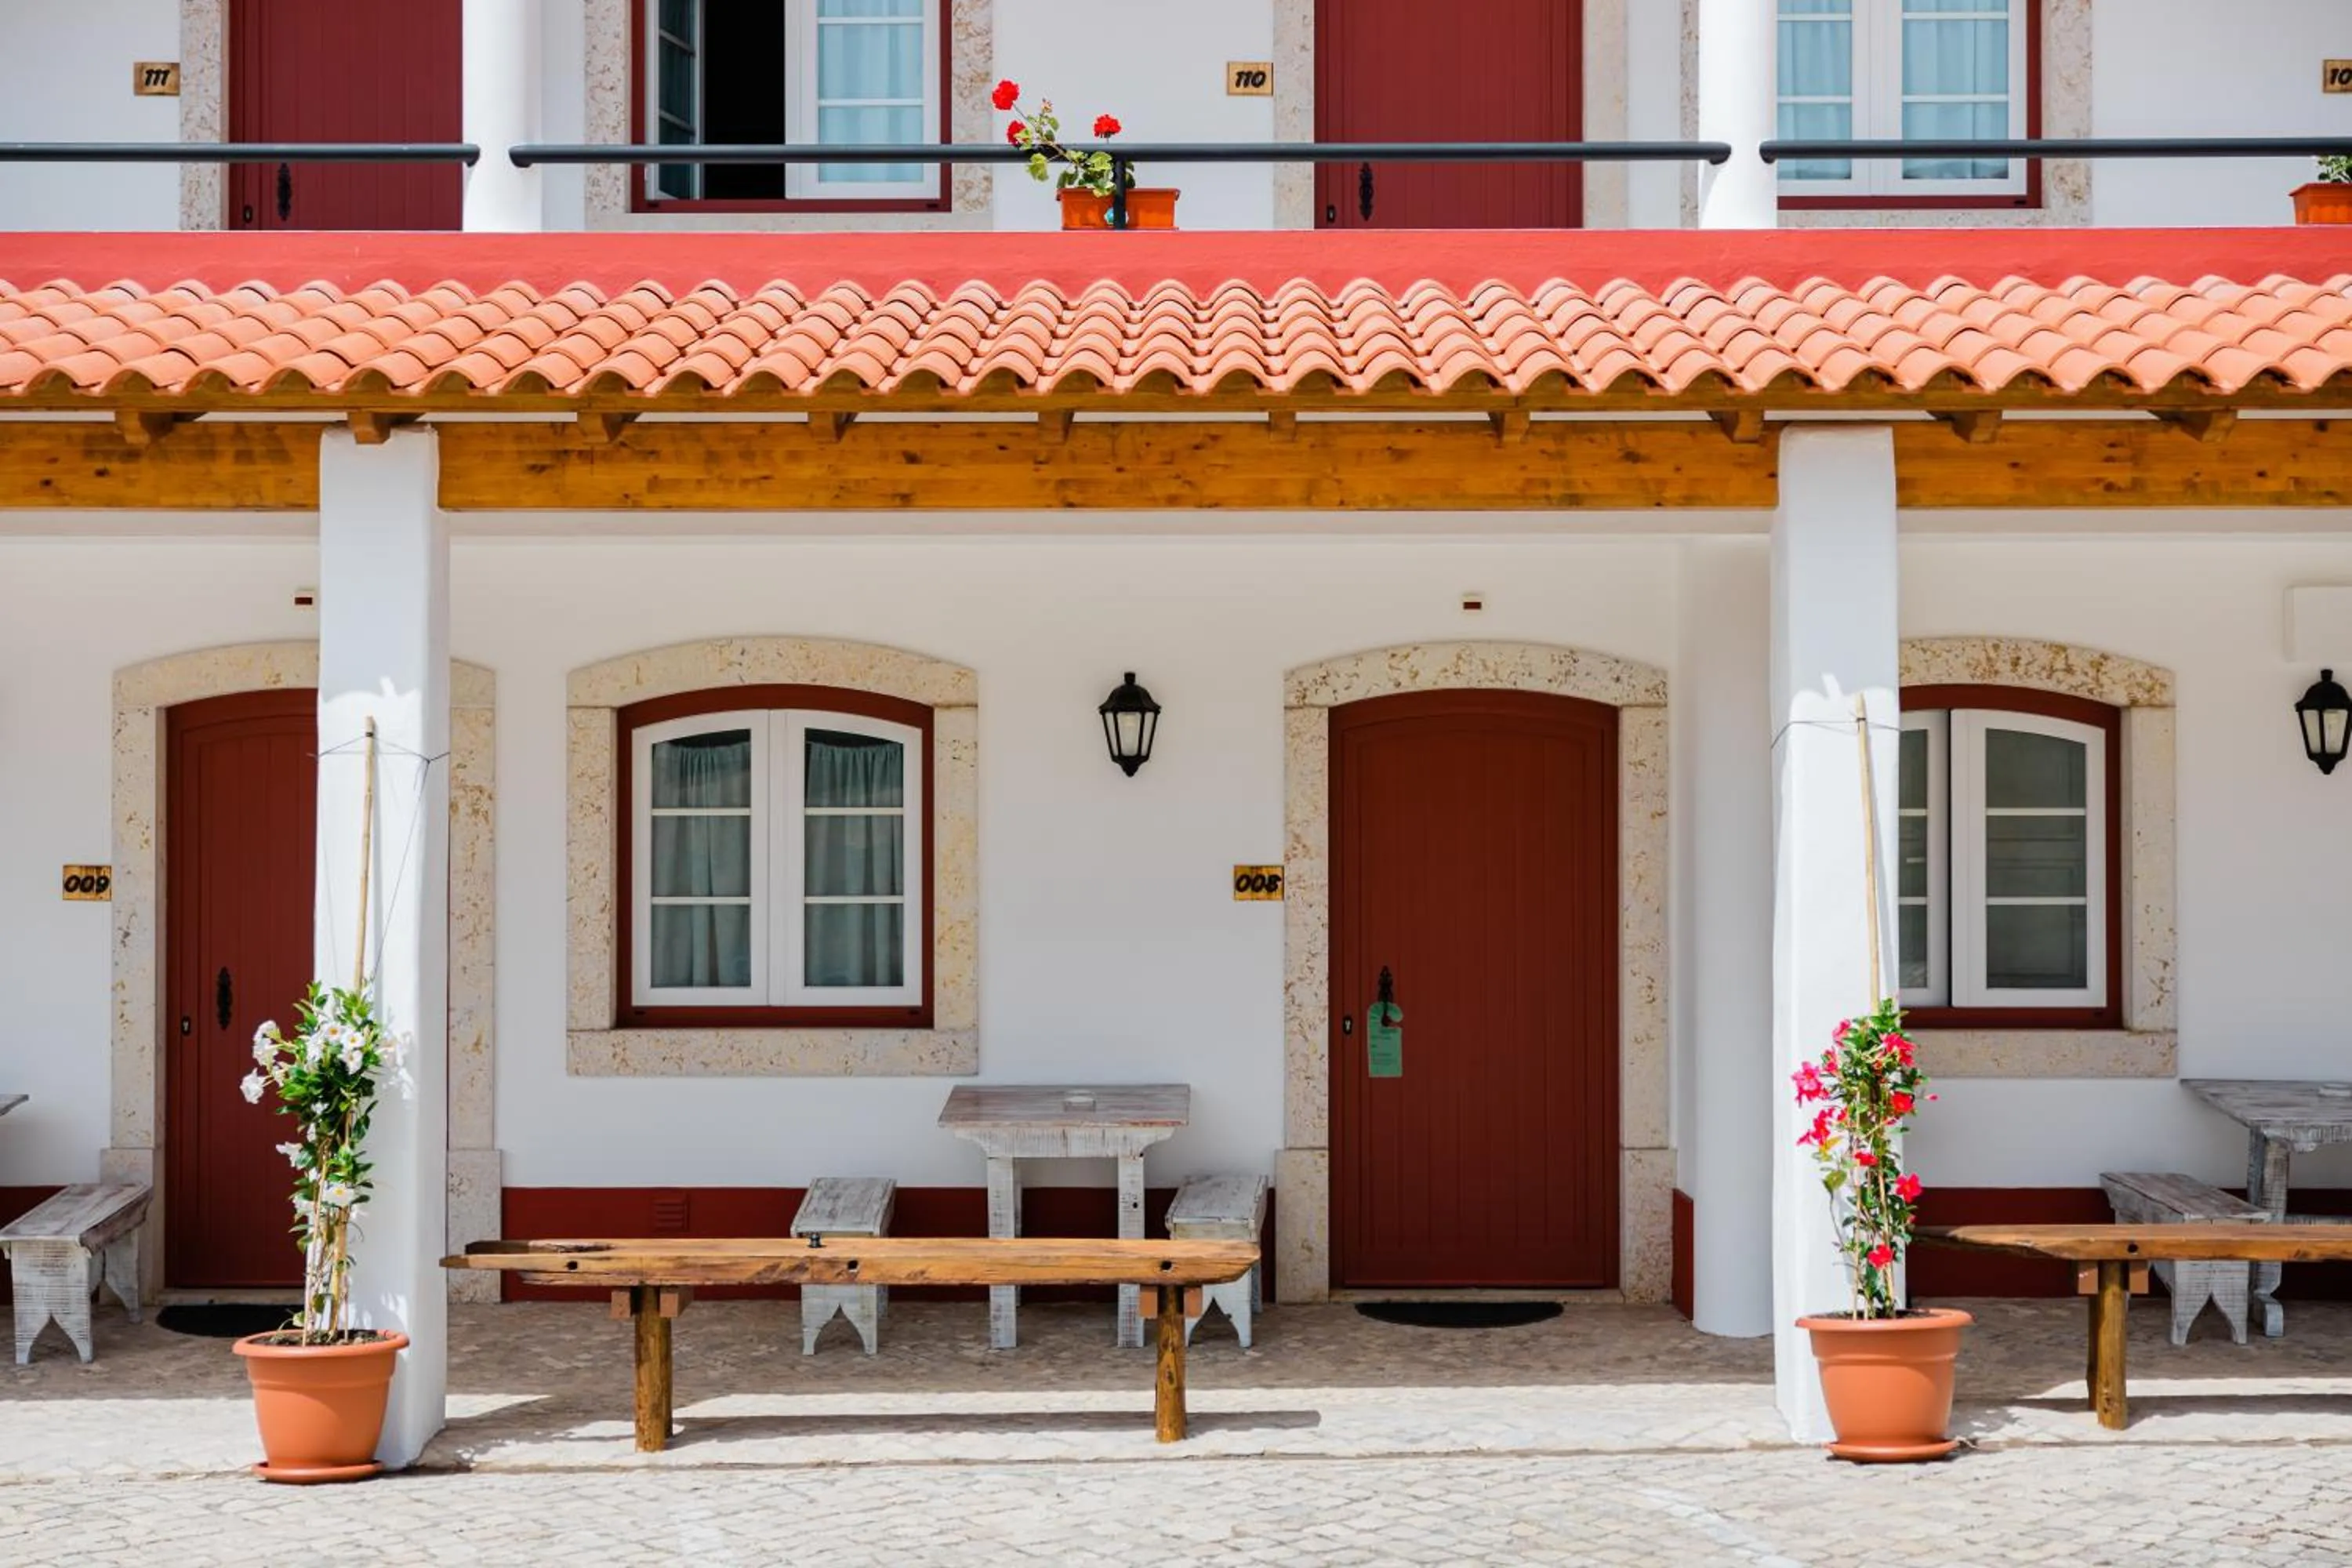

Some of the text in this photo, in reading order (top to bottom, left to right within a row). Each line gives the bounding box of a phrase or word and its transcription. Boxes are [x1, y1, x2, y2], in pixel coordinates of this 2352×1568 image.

[145, 68, 170, 86] 111
[1235, 71, 1266, 88] 110
[64, 875, 109, 893] 009
[1236, 874, 1281, 893] 008
